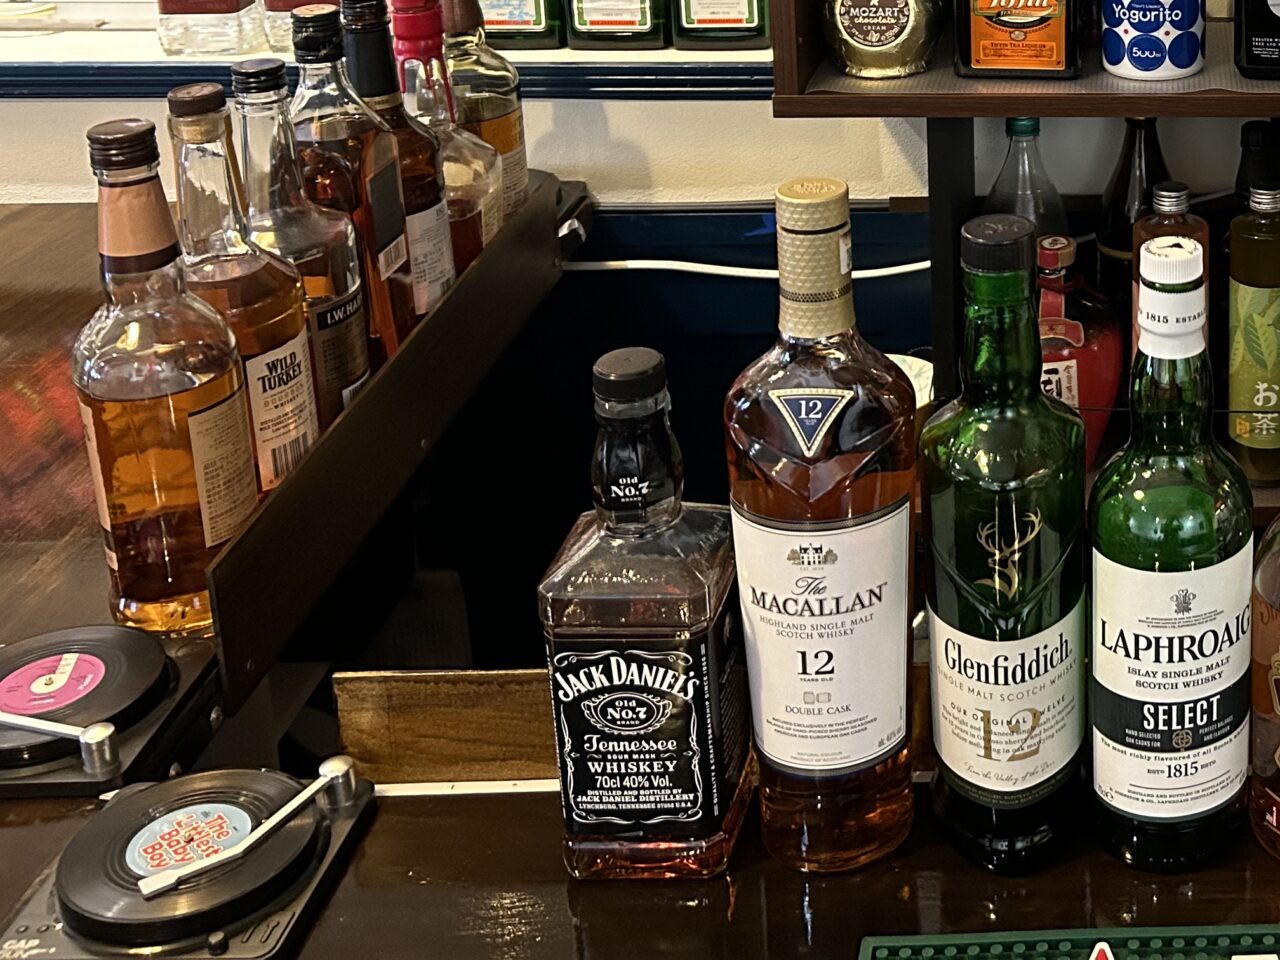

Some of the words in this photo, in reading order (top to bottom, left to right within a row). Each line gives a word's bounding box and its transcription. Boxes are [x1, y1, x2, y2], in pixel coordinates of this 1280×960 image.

[850, 8, 899, 17] MOZART
[1113, 3, 1182, 23] Yogurito
[1146, 312, 1168, 323] 1815
[266, 351, 296, 374] WILD
[257, 360, 302, 393] TURKEY
[799, 399, 822, 418] 12
[611, 481, 649, 497] No.7
[791, 576, 827, 596] The
[750, 584, 883, 617] MACALLAN
[760, 615, 806, 630] HIGHLAND
[811, 621, 846, 631] SINGLE
[851, 614, 874, 626] MALT
[776, 629, 813, 639] SCOTCH
[818, 628, 855, 639] WHISKY
[1101, 604, 1250, 663] LAPHROAIG
[797, 650, 835, 675] 12
[945, 633, 1069, 686] Glenfiddich
[1128, 666, 1158, 678] ISLAY
[1162, 667, 1202, 678] SINGLE
[1206, 656, 1231, 672] MALT
[555, 663, 610, 702] JACK
[610, 656, 699, 700] DANIEL'S
[1136, 680, 1178, 689] SCOTCH
[1179, 671, 1224, 688] WHISKY
[968, 687, 993, 700] MALT
[1000, 683, 1046, 702] SCOTCH
[606, 707, 647, 719] No.7
[785, 705, 823, 715] DOUBLE
[827, 704, 852, 714] CASK
[951, 702, 967, 716] OUR
[973, 713, 1027, 726] ORIGINAL
[1143, 695, 1220, 730] SELECT
[584, 735, 677, 752] Tennessee
[975, 707, 1041, 762] 12
[587, 761, 677, 773] WHISKEY
[1166, 761, 1198, 778] 1815
[595, 776, 620, 788] 70cl
[623, 776, 649, 787] 40%
[651, 775, 672, 787] Vol.
[206, 814, 231, 840] The
[141, 841, 170, 869] Boy
[158, 828, 195, 863] Baby
